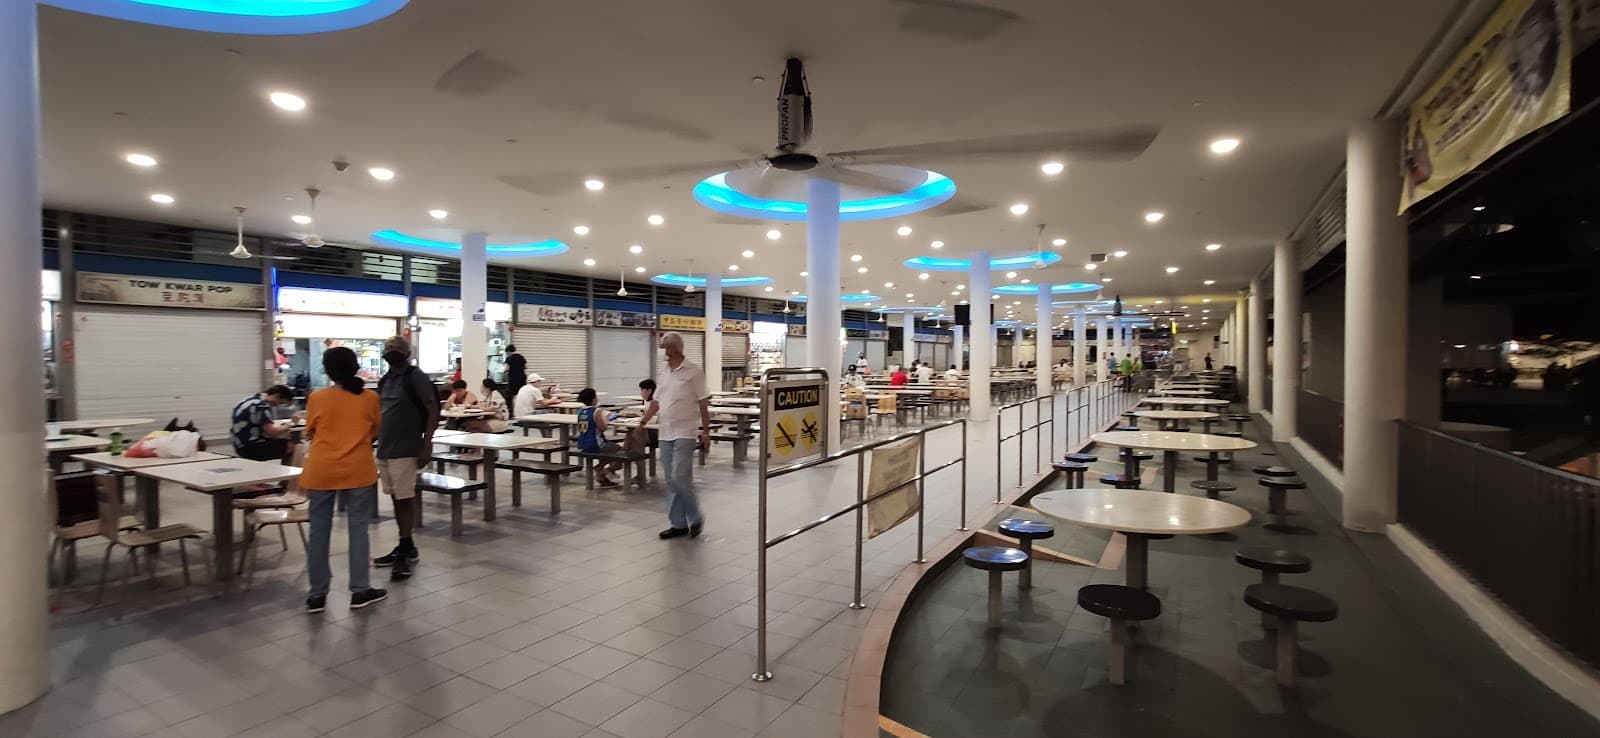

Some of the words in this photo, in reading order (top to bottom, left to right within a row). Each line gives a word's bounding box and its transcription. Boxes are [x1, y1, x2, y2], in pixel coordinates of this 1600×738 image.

[781, 98, 789, 141] PROFAN
[129, 280, 159, 289] TOW
[165, 282, 202, 292] KWAR
[208, 285, 232, 294] POP
[777, 389, 818, 407] CAUTION
